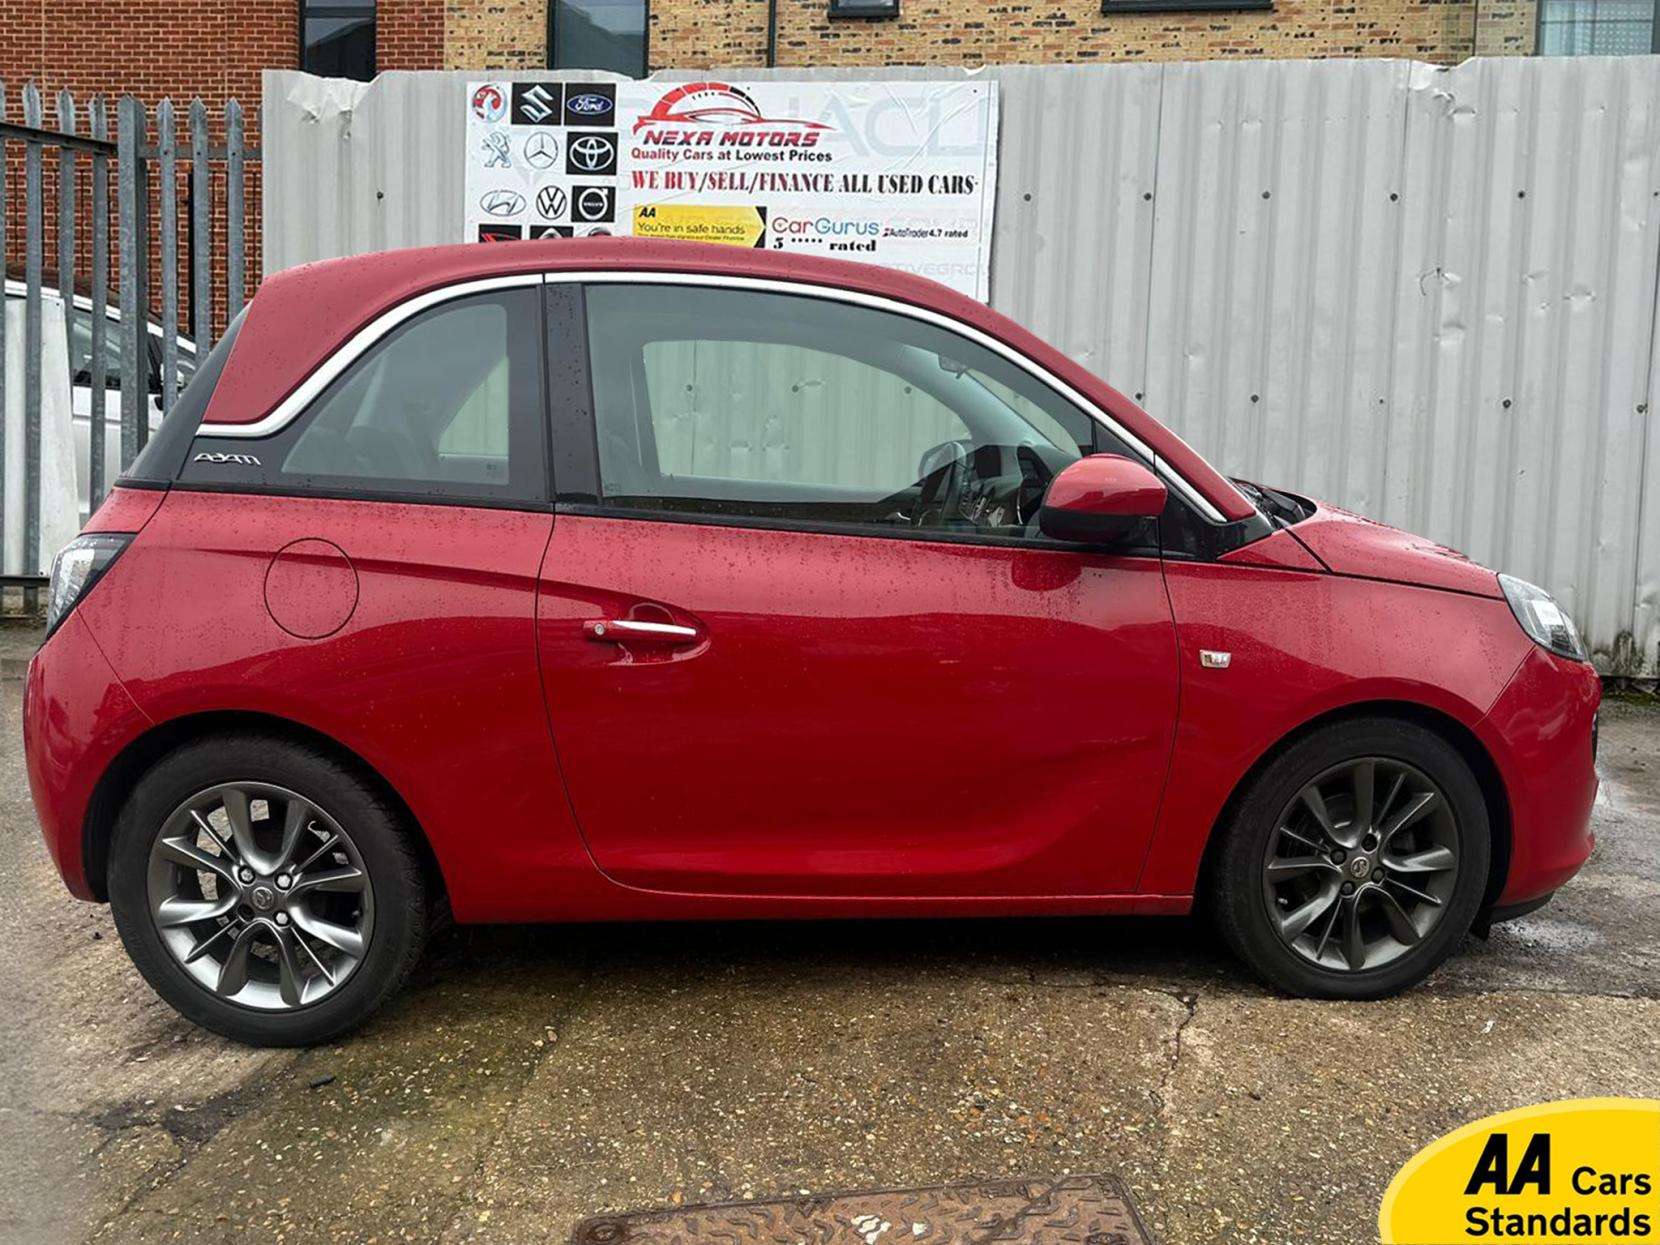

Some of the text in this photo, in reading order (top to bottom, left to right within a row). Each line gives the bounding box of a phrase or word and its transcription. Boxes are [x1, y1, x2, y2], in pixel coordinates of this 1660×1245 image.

[575, 97, 604, 112] Ford
[643, 130, 820, 147] NEXA MOTORS
[631, 147, 832, 162] Quality Cars at Lowest Prices
[631, 170, 659, 189] WE
[839, 174, 872, 193] ALL
[878, 175, 923, 194] USED
[639, 207, 656, 218] AA
[638, 223, 670, 232] You're
[687, 224, 708, 234] safe
[711, 224, 746, 235] hands
[772, 217, 880, 236] CarGurus
[944, 230, 968, 238] rated
[773, 237, 876, 252] 5 rated
